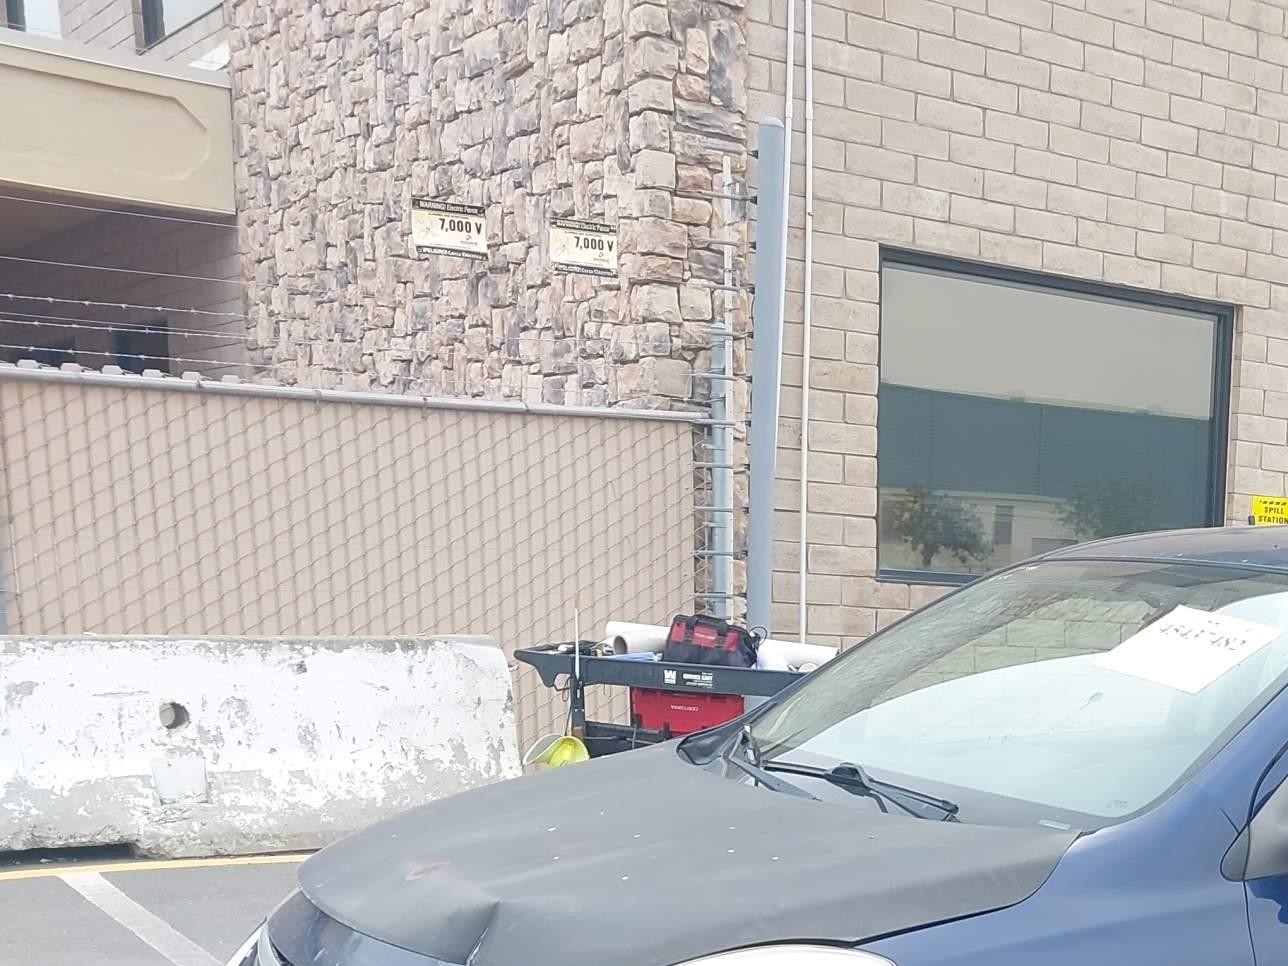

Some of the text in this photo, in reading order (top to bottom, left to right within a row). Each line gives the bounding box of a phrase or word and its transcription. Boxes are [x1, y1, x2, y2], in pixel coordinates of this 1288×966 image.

[439, 218, 482, 235] 7,000 V
[574, 236, 614, 252] 7,000 V
[1264, 506, 1285, 514] SPILL
[1258, 514, 1288, 525] STATION
